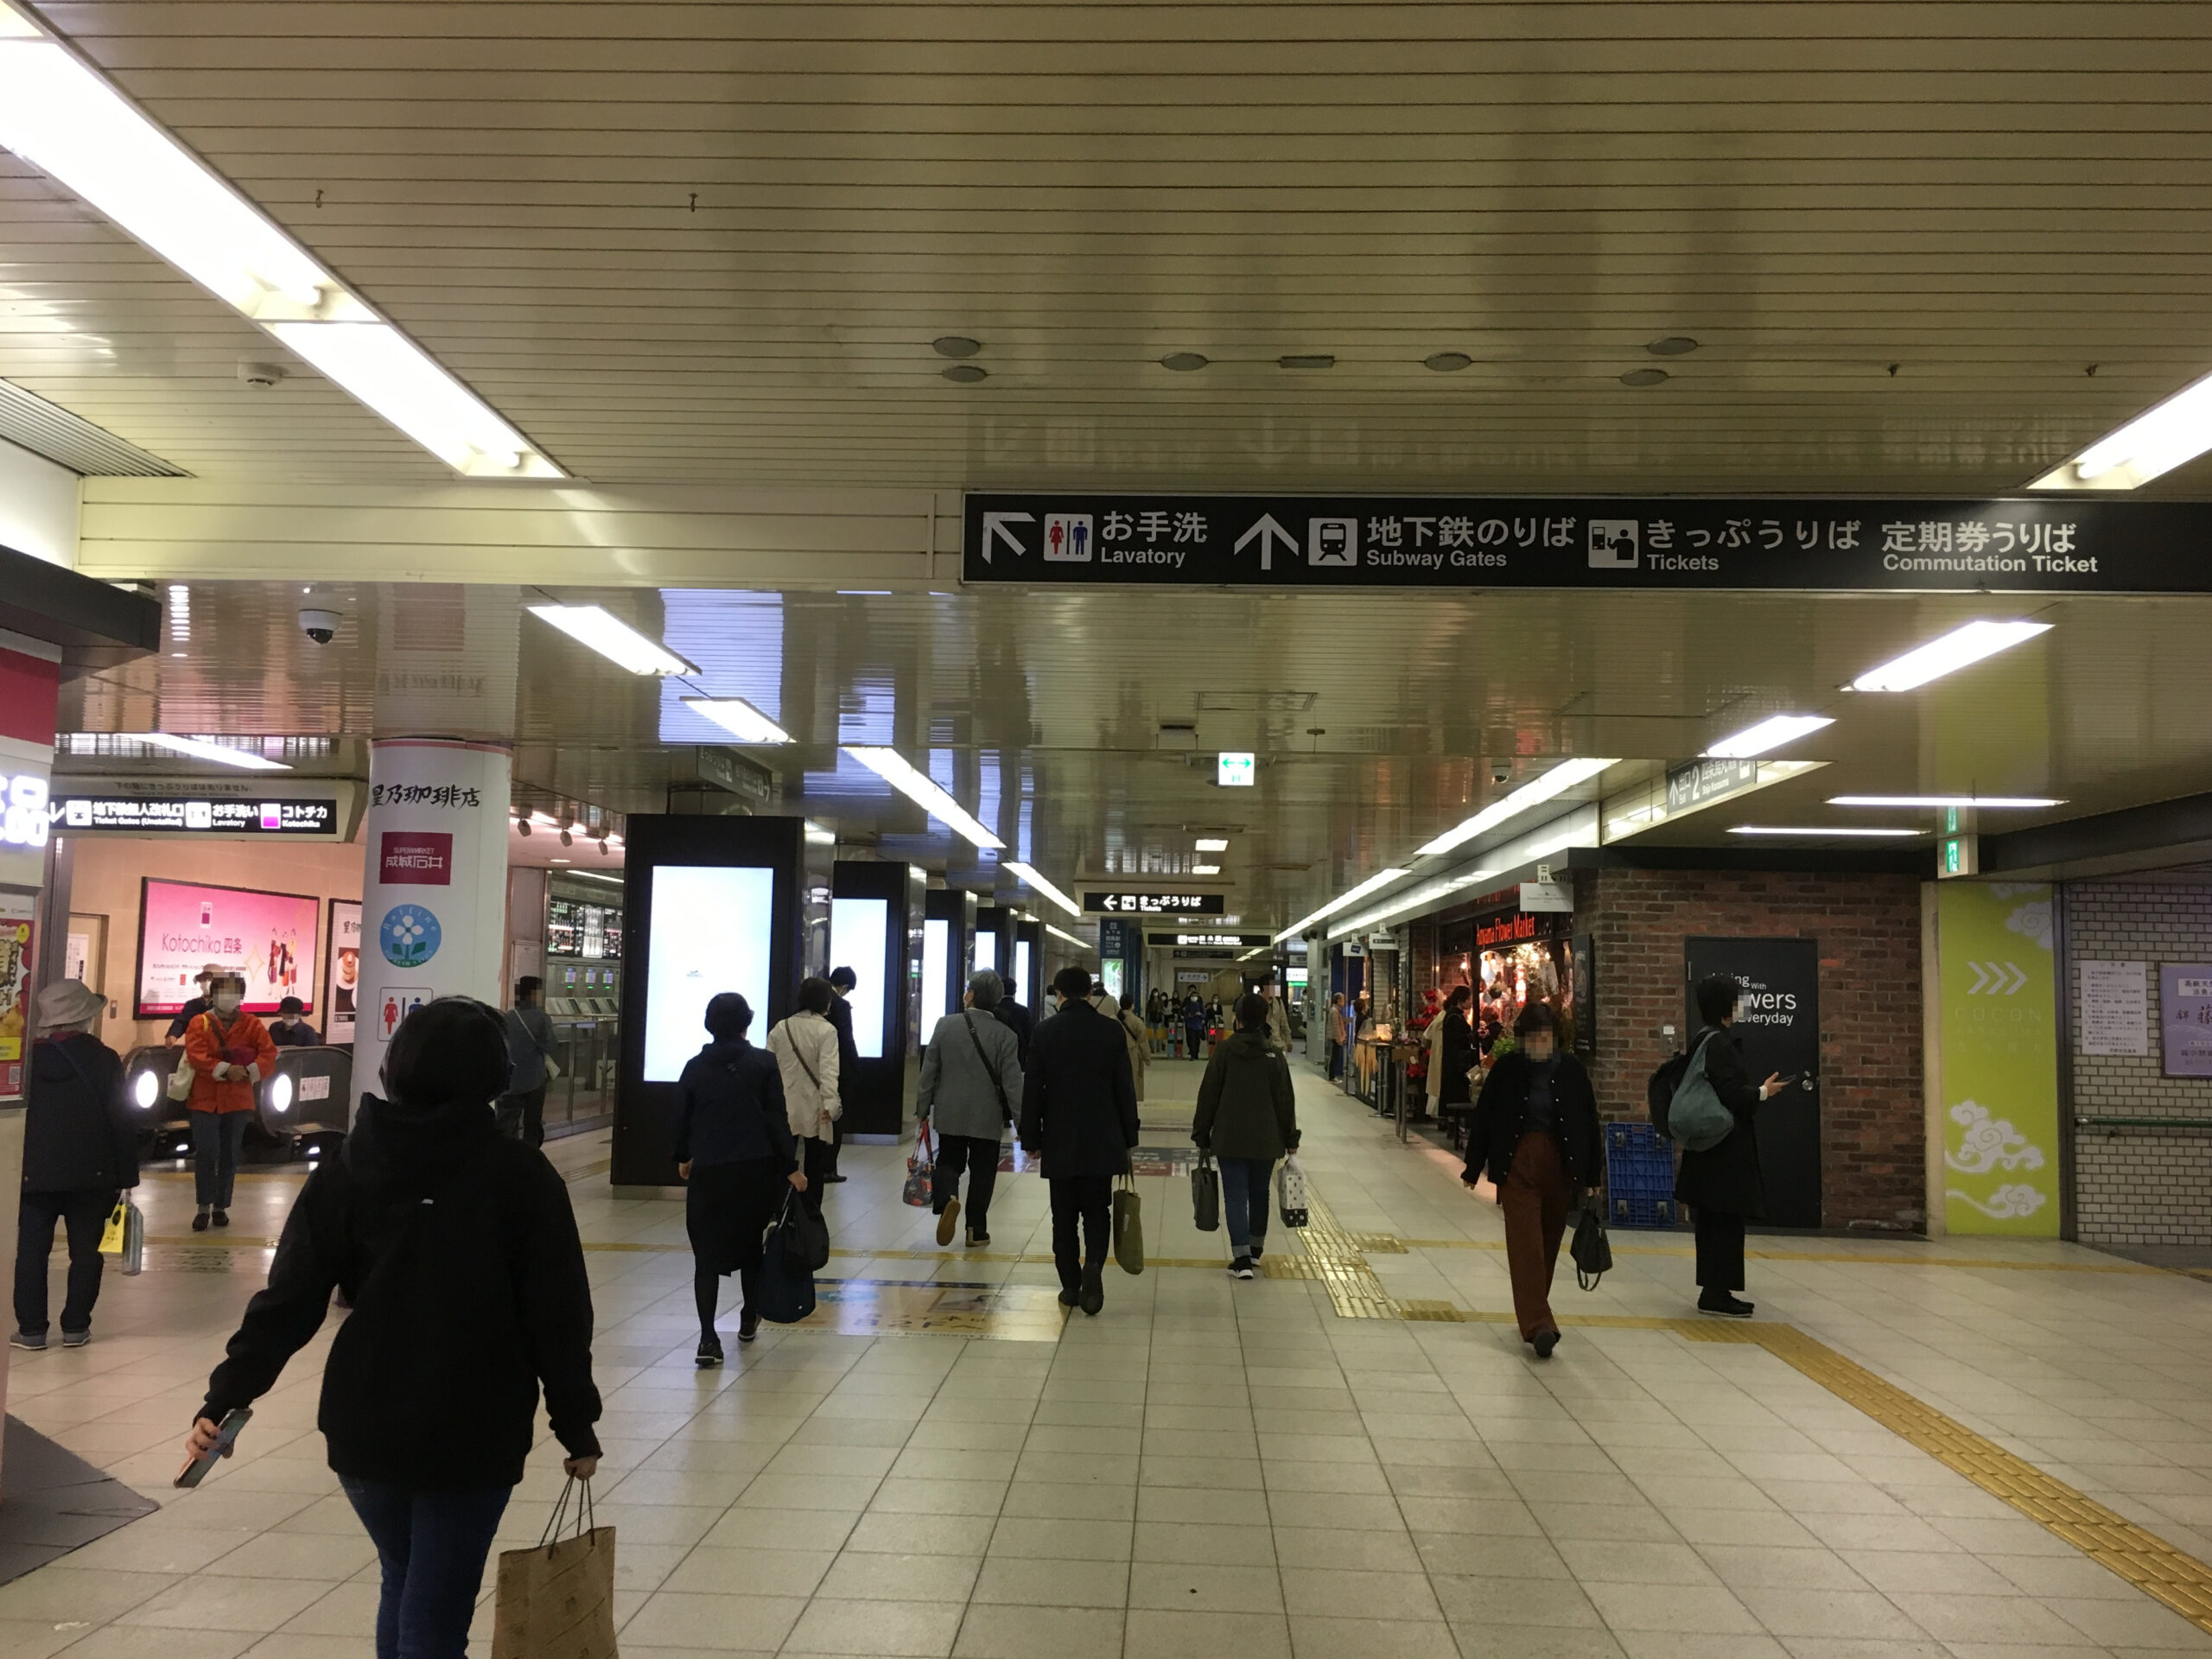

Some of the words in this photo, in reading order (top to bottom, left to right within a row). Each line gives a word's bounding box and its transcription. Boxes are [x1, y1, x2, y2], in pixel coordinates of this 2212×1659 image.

[1102, 511, 1208, 543] お手洗
[1367, 516, 1577, 548] 地下鉄のりば
[1647, 518, 1861, 550] きっぷうりば
[1881, 521, 2077, 553] 定期券うりば
[1101, 547, 1185, 569] Lavatory
[1367, 550, 1443, 570] Subway
[1450, 550, 1507, 567] Gates
[1646, 554, 1719, 570] Tickets
[1883, 554, 2026, 572] Commutation
[2032, 556, 2099, 572] Ticket
[1679, 771, 1691, 791] 出口
[1692, 766, 1700, 801] 2
[372, 784, 481, 809] 星乃珈琲店
[282, 805, 327, 818] コトチカ
[385, 855, 443, 869] 成城石井
[1514, 911, 1535, 939] Market
[162, 933, 221, 954] Kotochika
[224, 938, 242, 955] 四条
[1955, 1007, 2042, 1022] COCON
